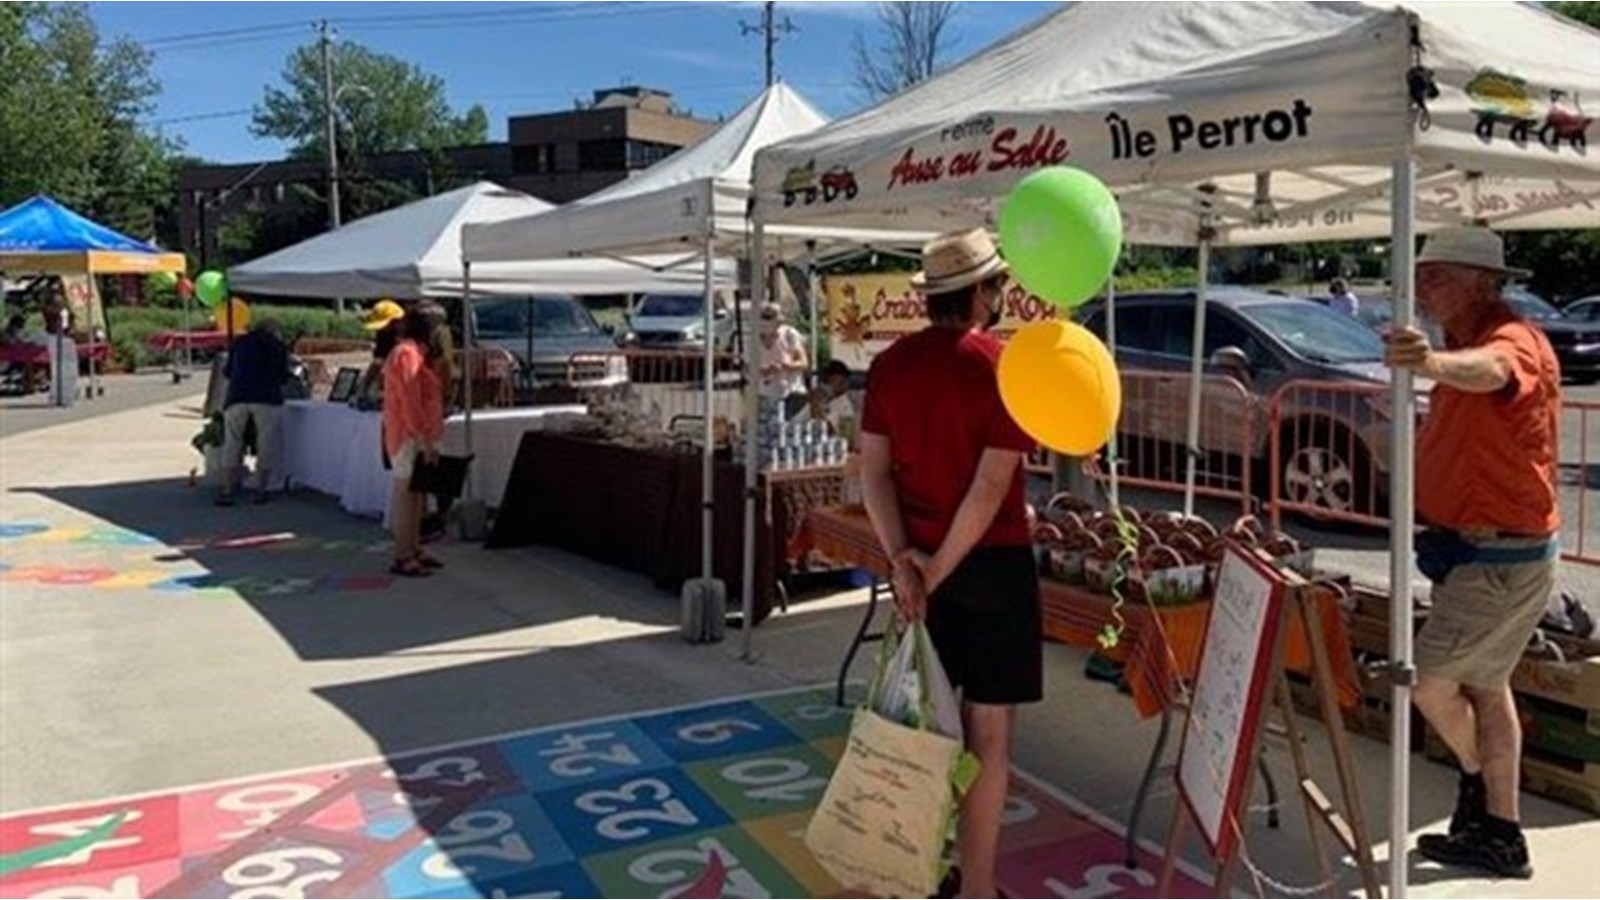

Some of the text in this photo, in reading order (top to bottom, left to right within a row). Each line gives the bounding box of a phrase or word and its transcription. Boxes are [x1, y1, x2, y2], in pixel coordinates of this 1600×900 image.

[887, 124, 1070, 190] Anse au Sable
[1107, 99, 1312, 159] Île Perrot
[538, 731, 640, 777] 24
[722, 757, 825, 800] 10
[574, 778, 698, 839] 23
